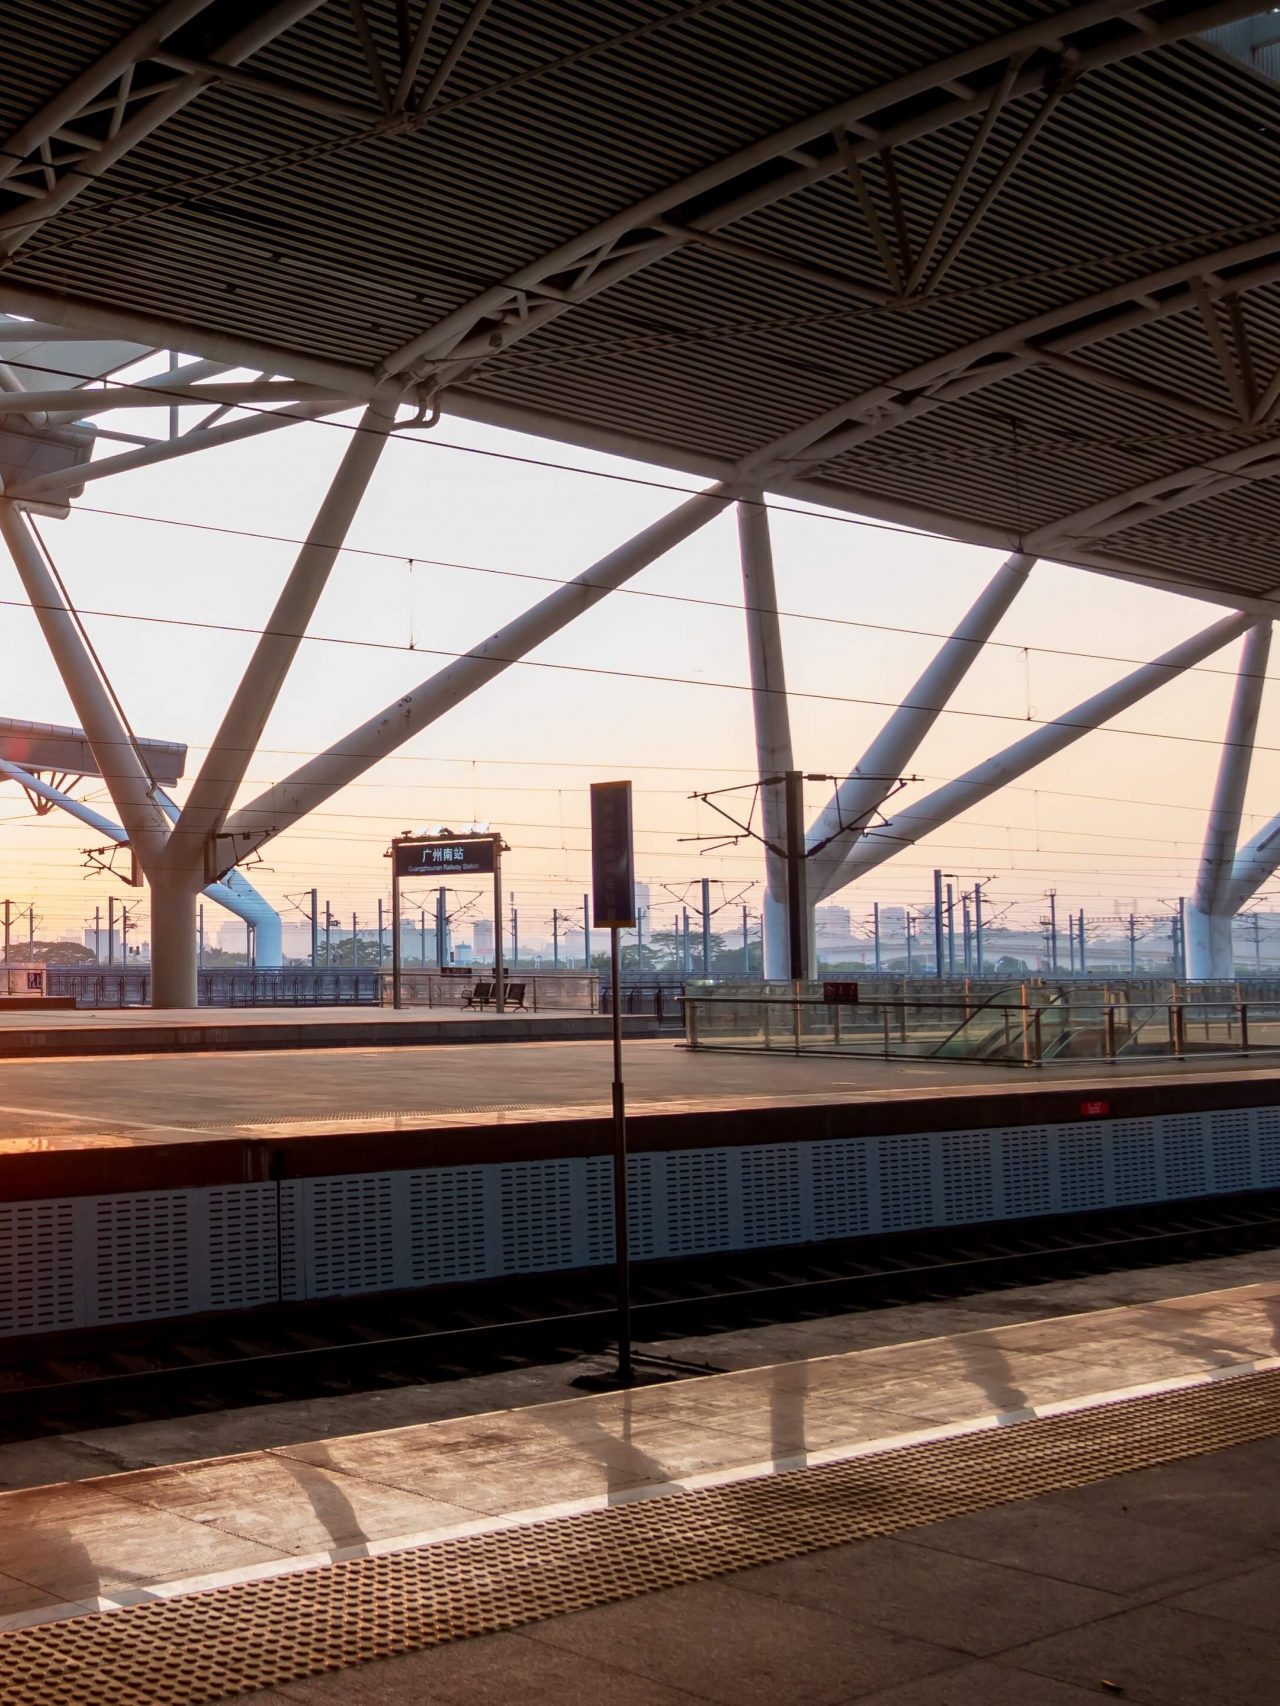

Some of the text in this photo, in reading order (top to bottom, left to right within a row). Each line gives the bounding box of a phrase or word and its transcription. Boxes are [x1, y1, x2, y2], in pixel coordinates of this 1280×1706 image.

[422, 846, 464, 862] 广州南站
[443, 863, 461, 871] Railway
